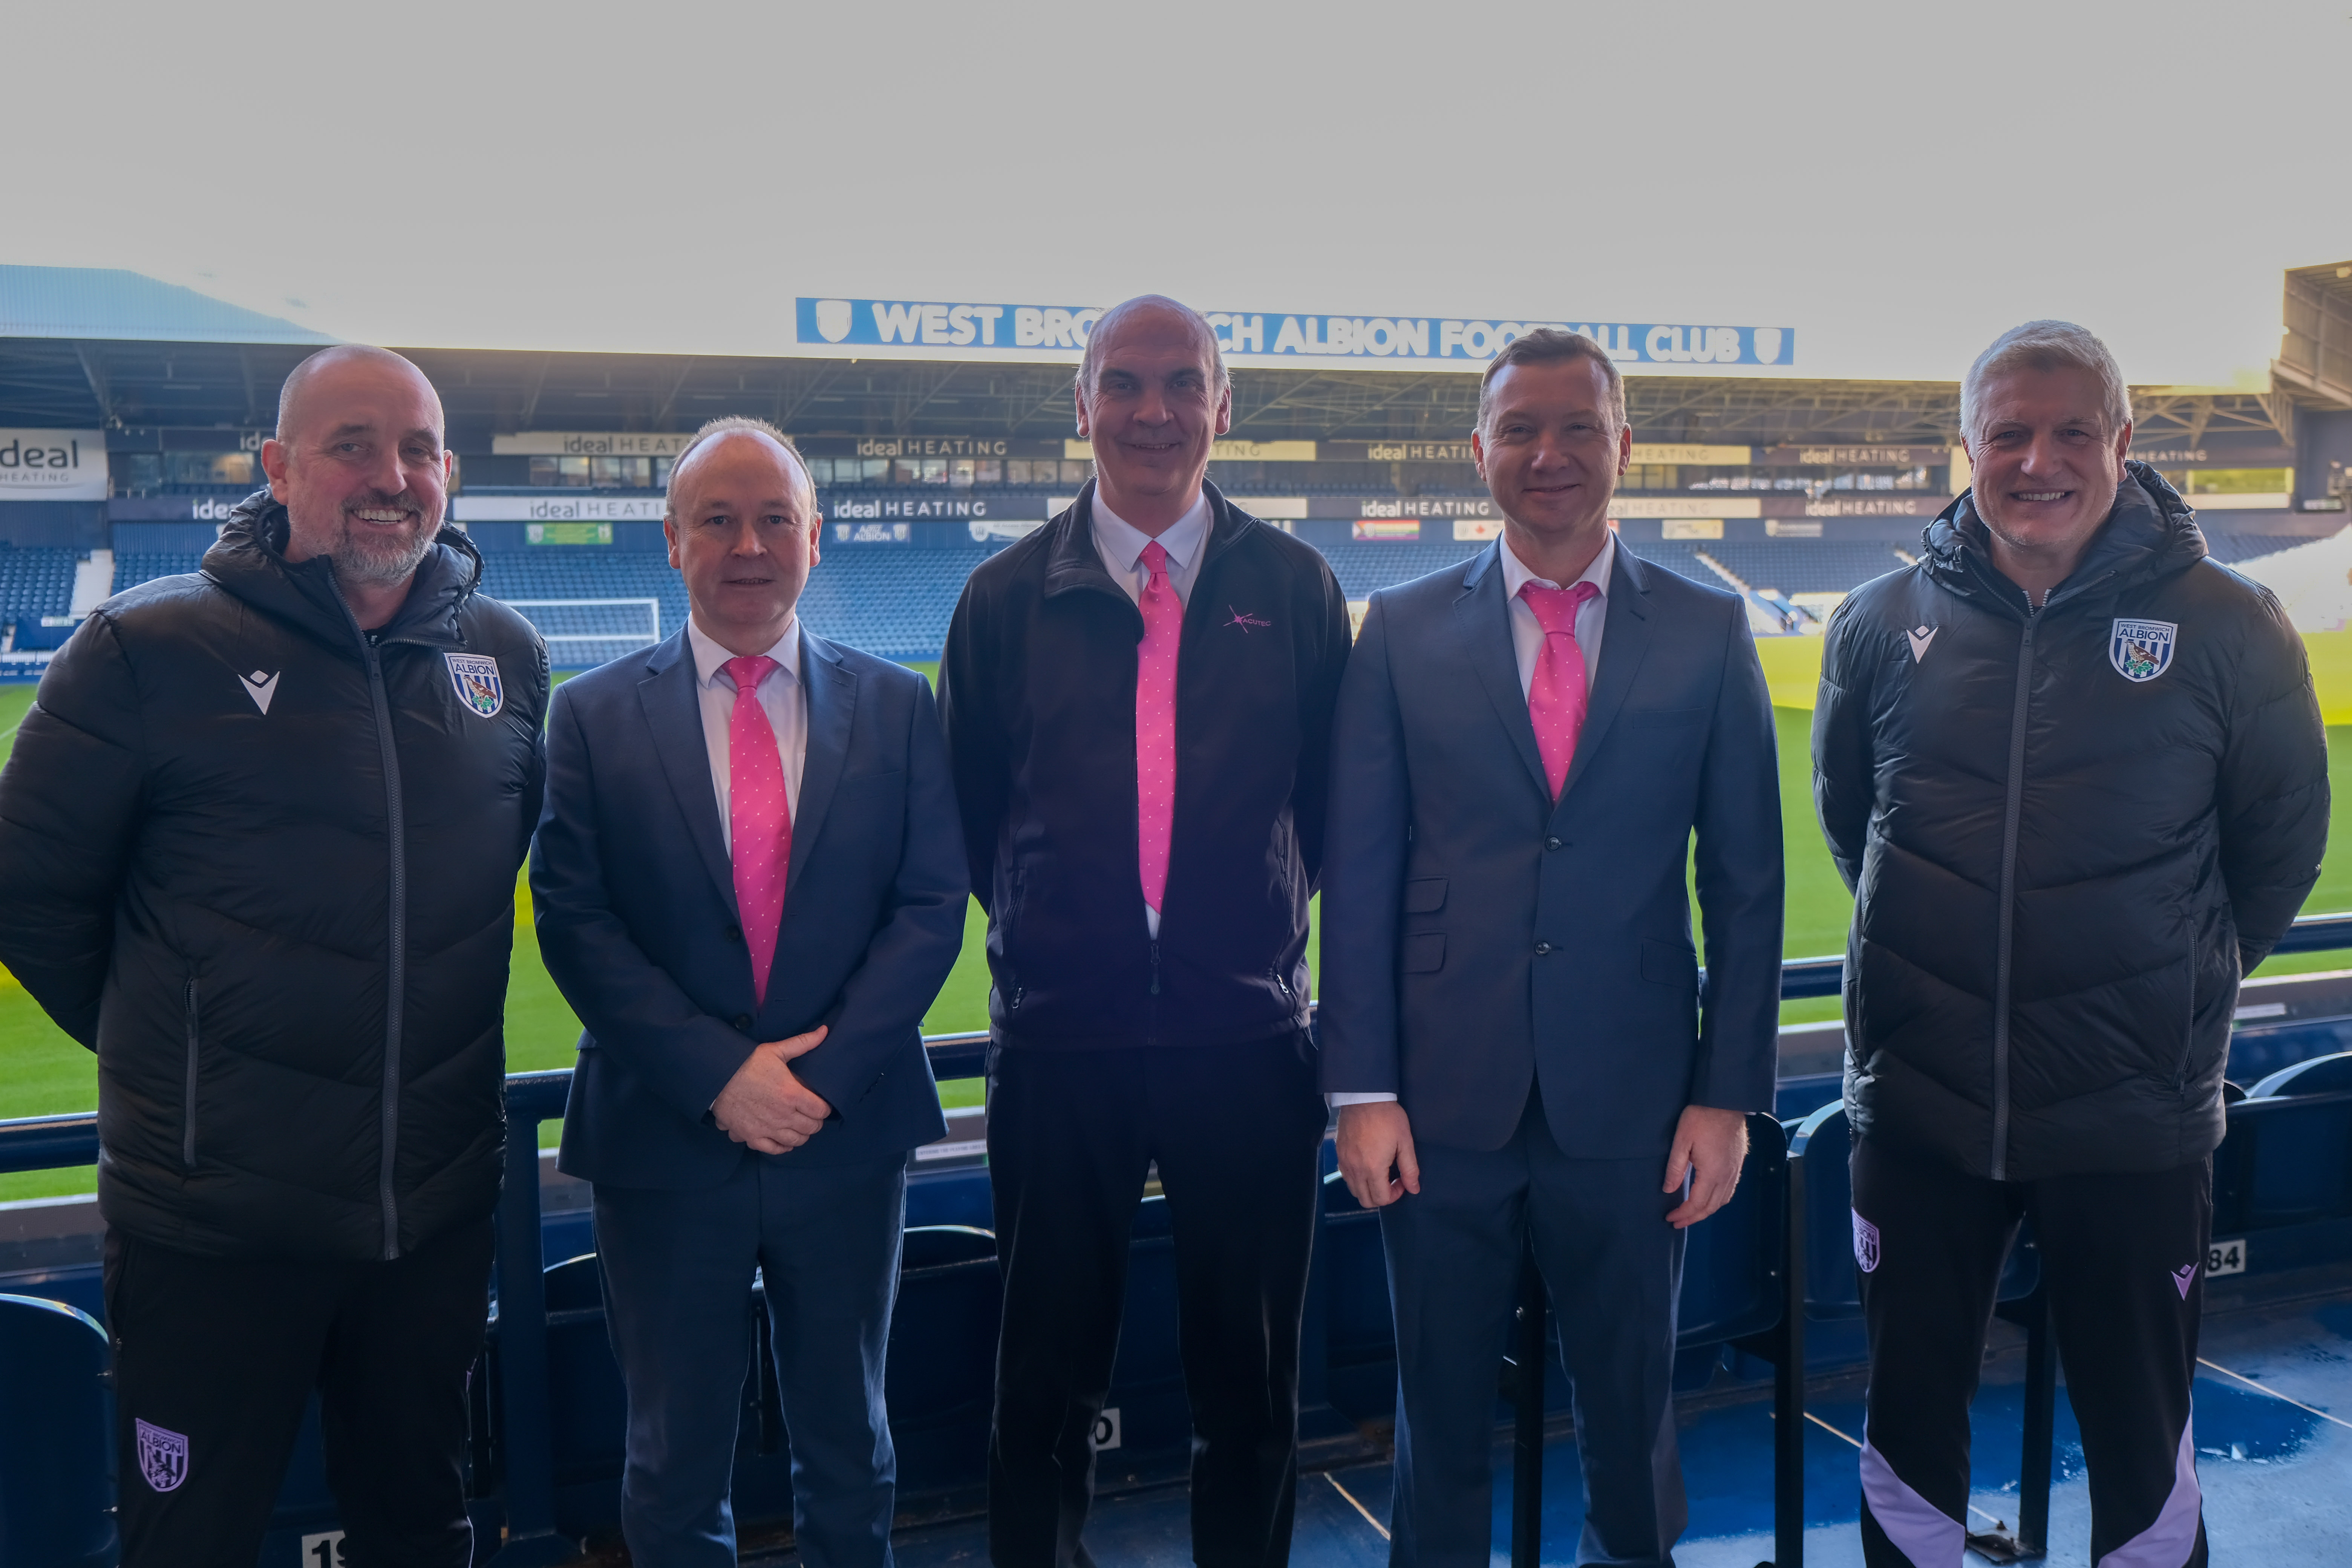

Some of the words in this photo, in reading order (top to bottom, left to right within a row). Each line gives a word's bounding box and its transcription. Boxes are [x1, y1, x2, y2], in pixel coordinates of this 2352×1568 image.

[871, 303, 1003, 345] WEST
[1015, 308, 1263, 352] BROCH
[1273, 317, 1429, 356] ALBION
[1440, 321, 1638, 361] FOOLL
[1645, 326, 1740, 363] CLUB
[564, 436, 613, 453] ideal
[620, 438, 689, 452] HEAT
[857, 439, 903, 456] ideal
[908, 441, 1007, 456] HEATING
[1213, 444, 1260, 456] TING
[1367, 444, 1407, 461] ideal
[1410, 445, 1473, 459] HEATI
[0, 439, 78, 468] deal
[1836, 449, 1910, 463] HEATING
[0, 473, 68, 483] HEATING
[192, 497, 239, 519] ide
[530, 500, 580, 518] ideal
[587, 502, 658, 517] HEATI
[834, 500, 881, 519] ideal
[886, 501, 987, 516] HEATING
[1361, 501, 1401, 517] ideal
[1404, 502, 1489, 516] HEATING
[1842, 500, 1916, 515] HEATING
[2119, 628, 2168, 641] ALBION
[456, 663, 495, 675] ALBION
[2207, 1246, 2240, 1272] 84
[1095, 1416, 1113, 1445] 0
[141, 1431, 181, 1454] ALBION
